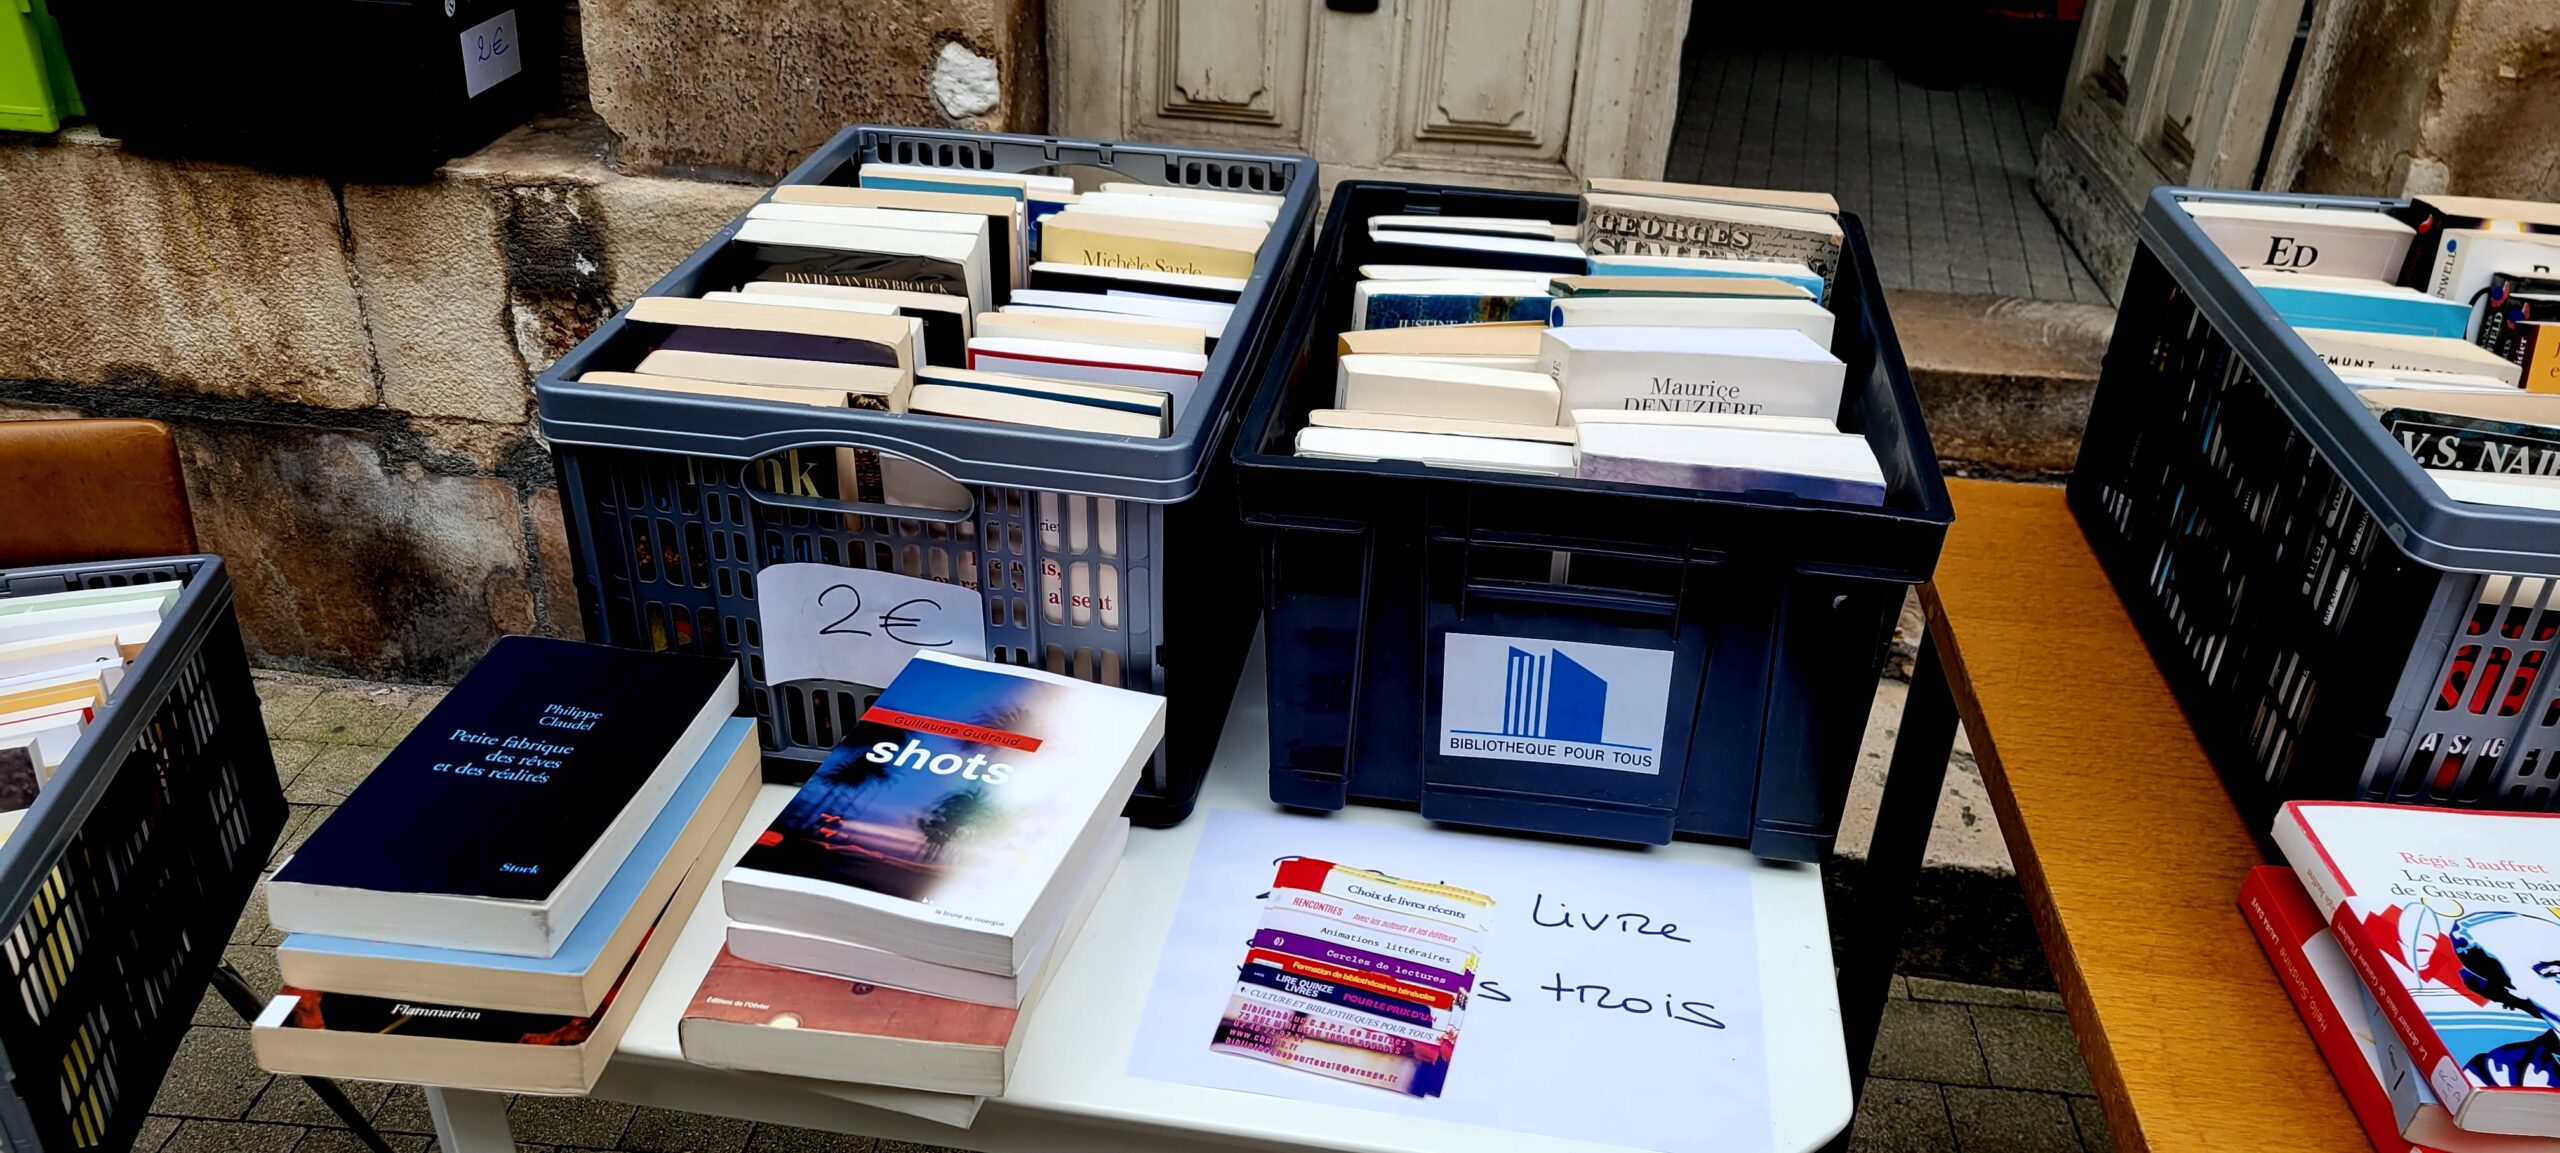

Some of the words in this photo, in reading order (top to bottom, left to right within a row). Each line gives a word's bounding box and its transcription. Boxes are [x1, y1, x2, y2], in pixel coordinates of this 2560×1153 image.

[477, 26, 509, 62] 2€
[1596, 213, 1752, 249] GEORGES
[2263, 236, 2319, 269] ED
[785, 271, 829, 285] DAVID
[834, 275, 862, 288] VAN
[1650, 377, 1741, 399] Maurice
[817, 584, 953, 647] 2€
[538, 716, 596, 731] Claudel
[544, 703, 603, 721] Philippe
[448, 729, 500, 746] Petite
[501, 735, 575, 756] fabrique
[894, 715, 959, 736] Guillaume
[962, 727, 1021, 747] Guéraud
[485, 750, 515, 764] des
[518, 756, 563, 769] rêves
[865, 739, 1015, 785] shots
[1450, 737, 1557, 757] BIBLIOTHEQUE
[1564, 746, 1605, 762] POUR
[1612, 751, 1653, 768] TOUS
[433, 764, 453, 772] et
[455, 762, 486, 776] des
[488, 768, 551, 783] réalités
[499, 862, 540, 875] Stock
[2398, 851, 2460, 869] Régis
[2464, 856, 2549, 874] Jauffret
[2400, 869, 2433, 883] Le
[2438, 872, 2516, 890] dernier
[1347, 885, 1380, 900] Choix
[1382, 893, 1397, 904] de
[1398, 896, 1427, 911] livres
[1427, 902, 1467, 919] récents
[2390, 883, 2417, 896] de
[2422, 884, 2511, 904] Gustave
[1292, 898, 1344, 917] RENCONTRES
[2250, 896, 2265, 921] DAVE
[2264, 918, 2280, 946] LAURA
[1320, 927, 1380, 947] Animations
[1385, 941, 1452, 965] littéraires
[1292, 961, 1332, 976] Formation
[1332, 970, 1342, 979] de
[1326, 949, 1371, 967] Cercles
[1376, 958, 1389, 971] de
[1395, 963, 1447, 984] lectures
[2279, 947, 2308, 1000] Sunshine
[1275, 973, 1299, 986] LIRE
[1299, 979, 1335, 994] QUINZE
[1285, 983, 1320, 998] LIVRES
[390, 1003, 481, 1020] Flammarion
[1250, 989, 1292, 1006] CULTURE
[1293, 999, 1306, 1009] ET
[1305, 1000, 1380, 1028] BIBLIOTHEQUES
[1380, 1021, 1408, 1034] POUR
[1408, 1028, 1434, 1041] TOUS
[1343, 993, 1374, 1007] POUR
[1374, 1000, 1385, 1011] LE
[1386, 1004, 1411, 1017] PRIX
[2308, 995, 2328, 1033] Hello,
